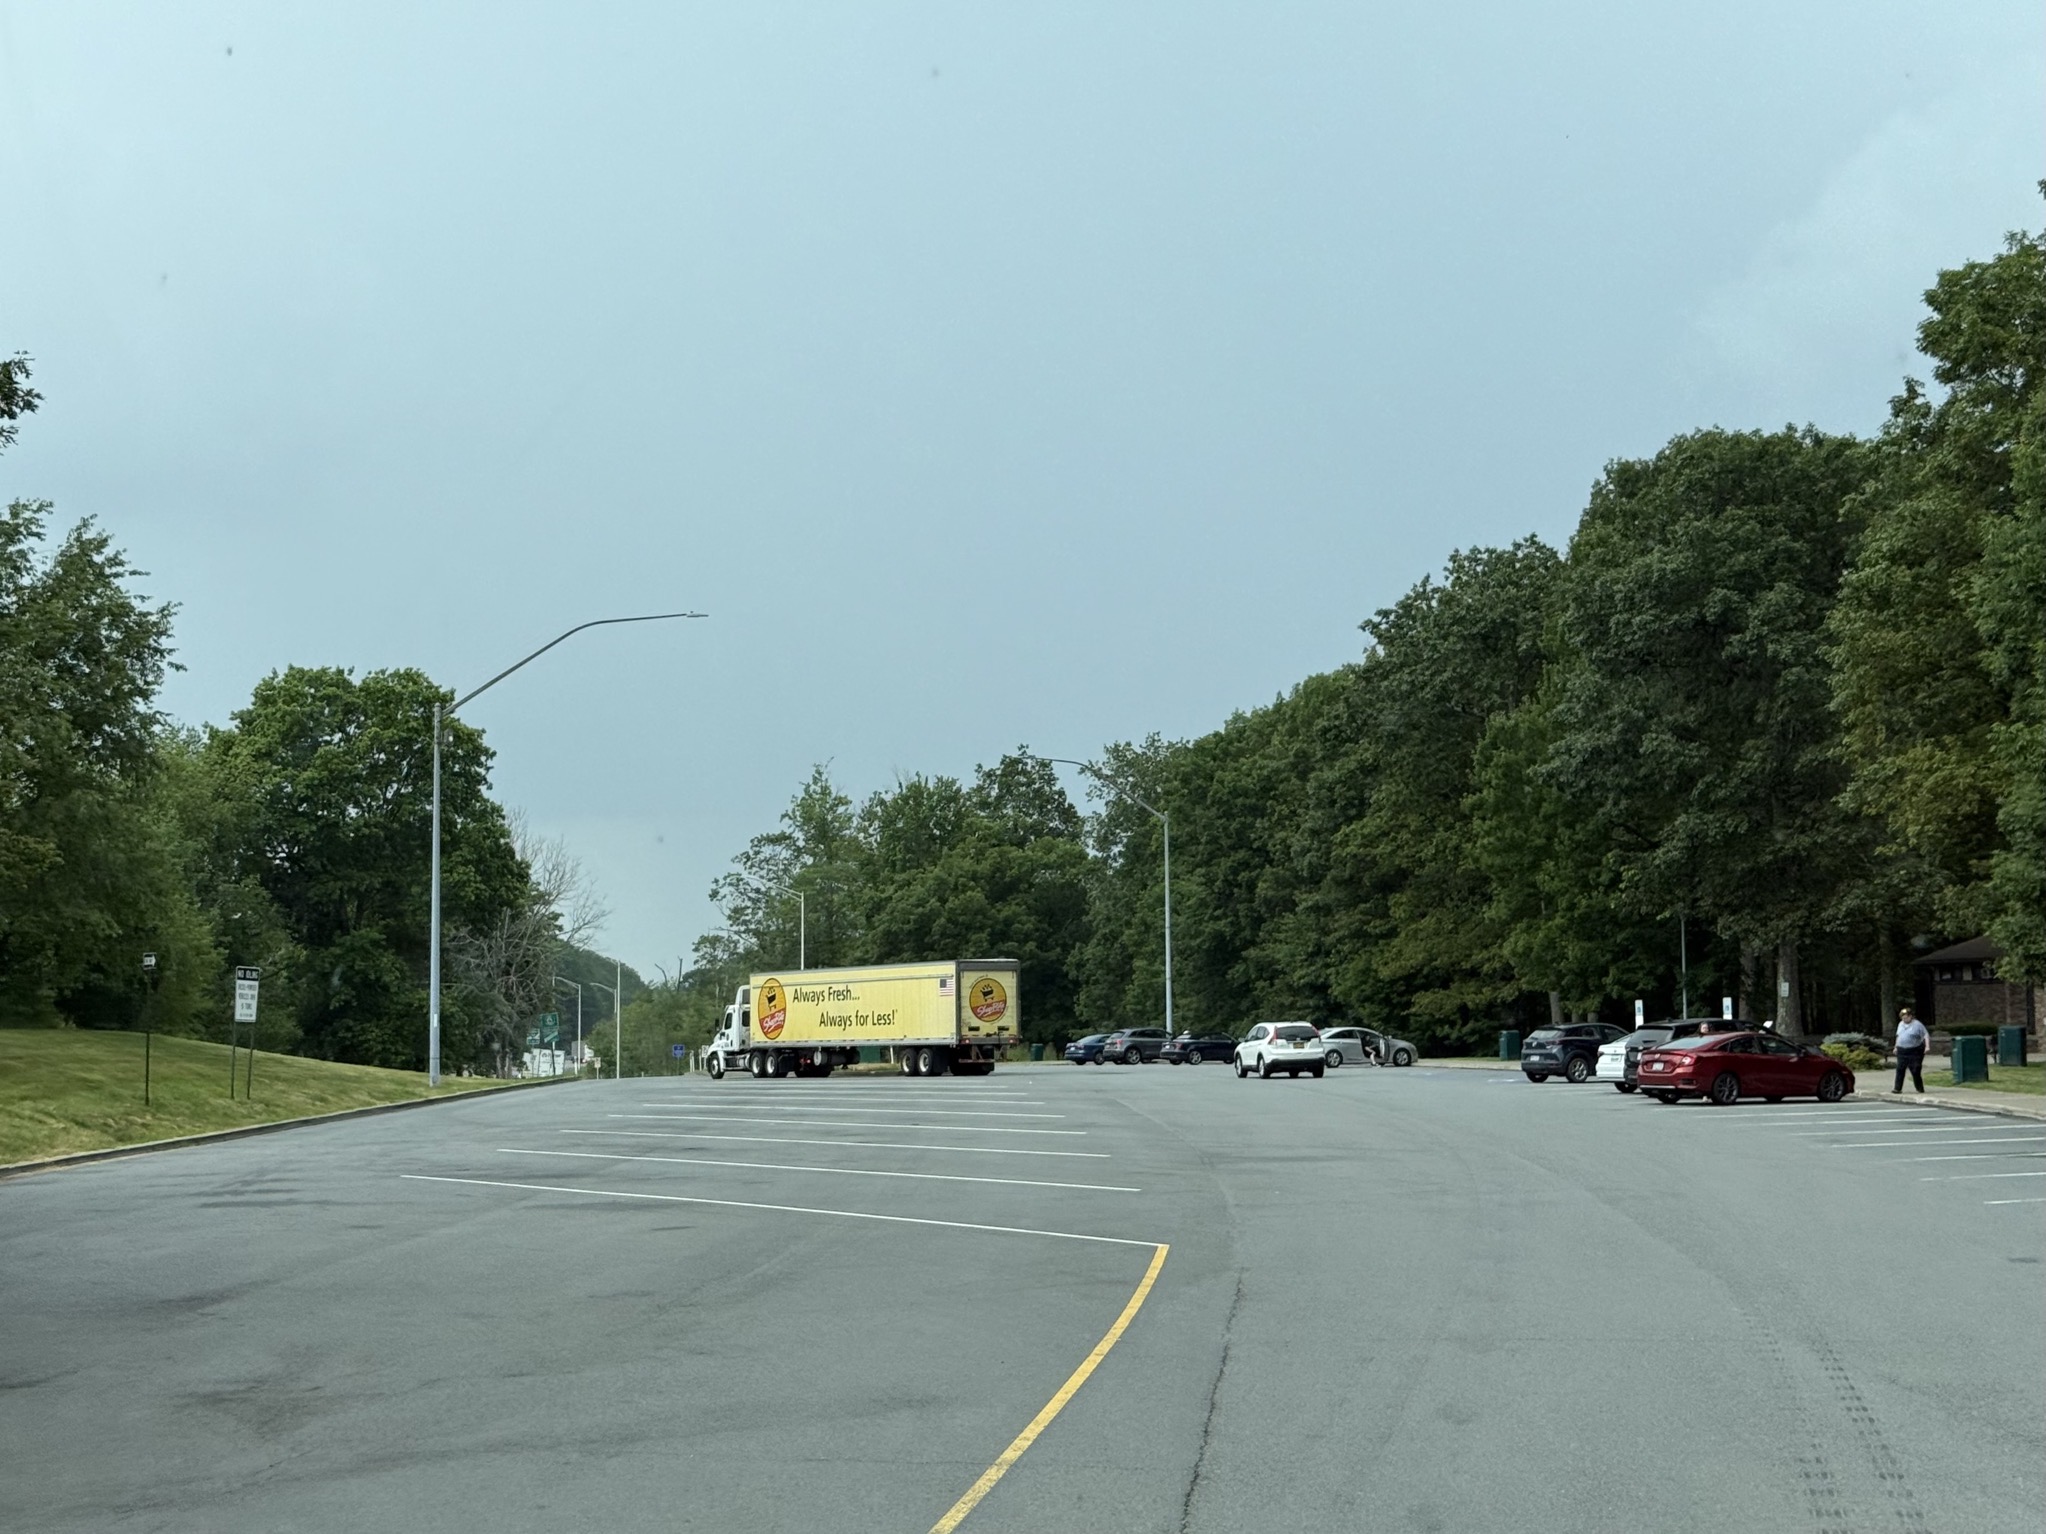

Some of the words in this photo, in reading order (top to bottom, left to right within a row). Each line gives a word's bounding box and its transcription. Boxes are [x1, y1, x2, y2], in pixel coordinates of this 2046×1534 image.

[793, 987, 825, 1006] Always
[819, 1011, 853, 1031] Always
[855, 1009, 869, 1026] for
[872, 1009, 895, 1026] Less!
